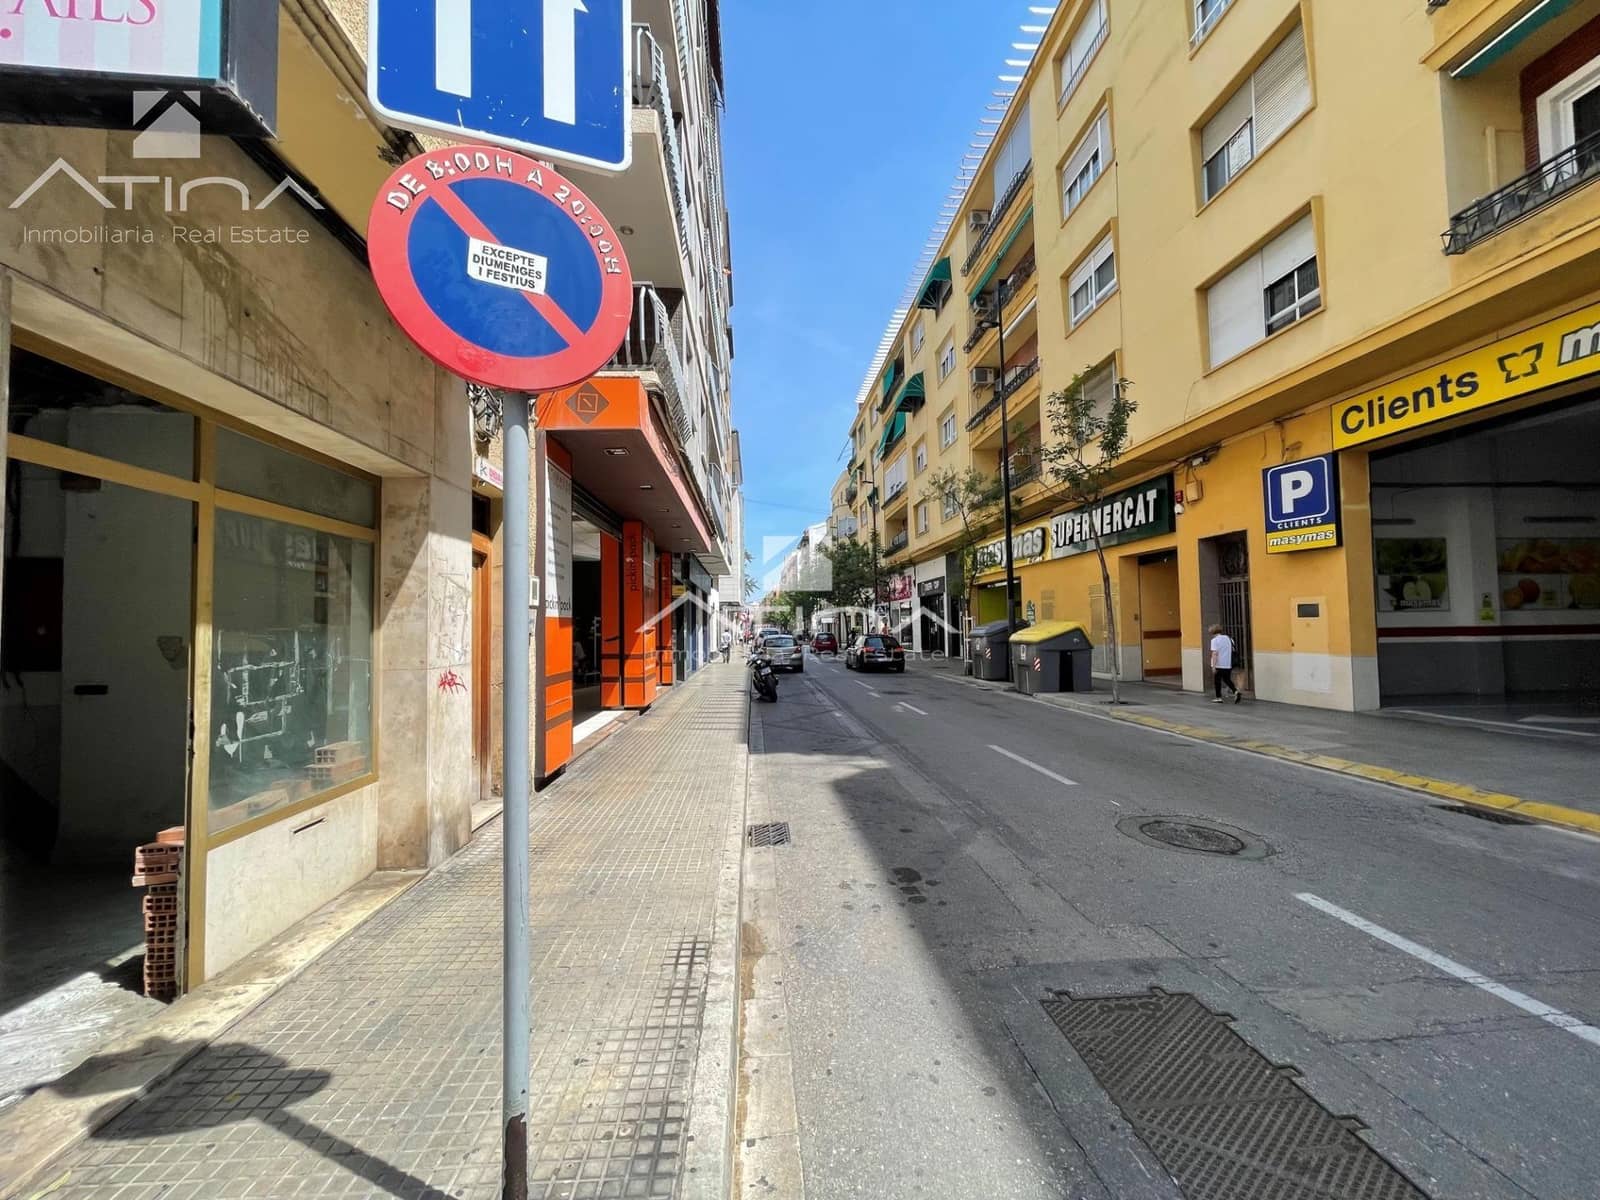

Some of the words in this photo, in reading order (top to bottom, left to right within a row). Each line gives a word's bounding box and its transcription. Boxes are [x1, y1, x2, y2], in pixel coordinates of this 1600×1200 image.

[387, 173, 427, 212] DE
[526, 168, 543, 189] A
[472, 253, 543, 280] DIUMENGES
[482, 245, 535, 267] EXCEPTE
[479, 266, 483, 276] I
[486, 268, 536, 289] FESTIUS
[1341, 371, 1480, 434] Clients
[1280, 470, 1314, 514] P
[1052, 488, 1157, 549] SUPERMERCAT
[1277, 517, 1322, 529] CLIENTS
[1269, 530, 1334, 547] masymas
